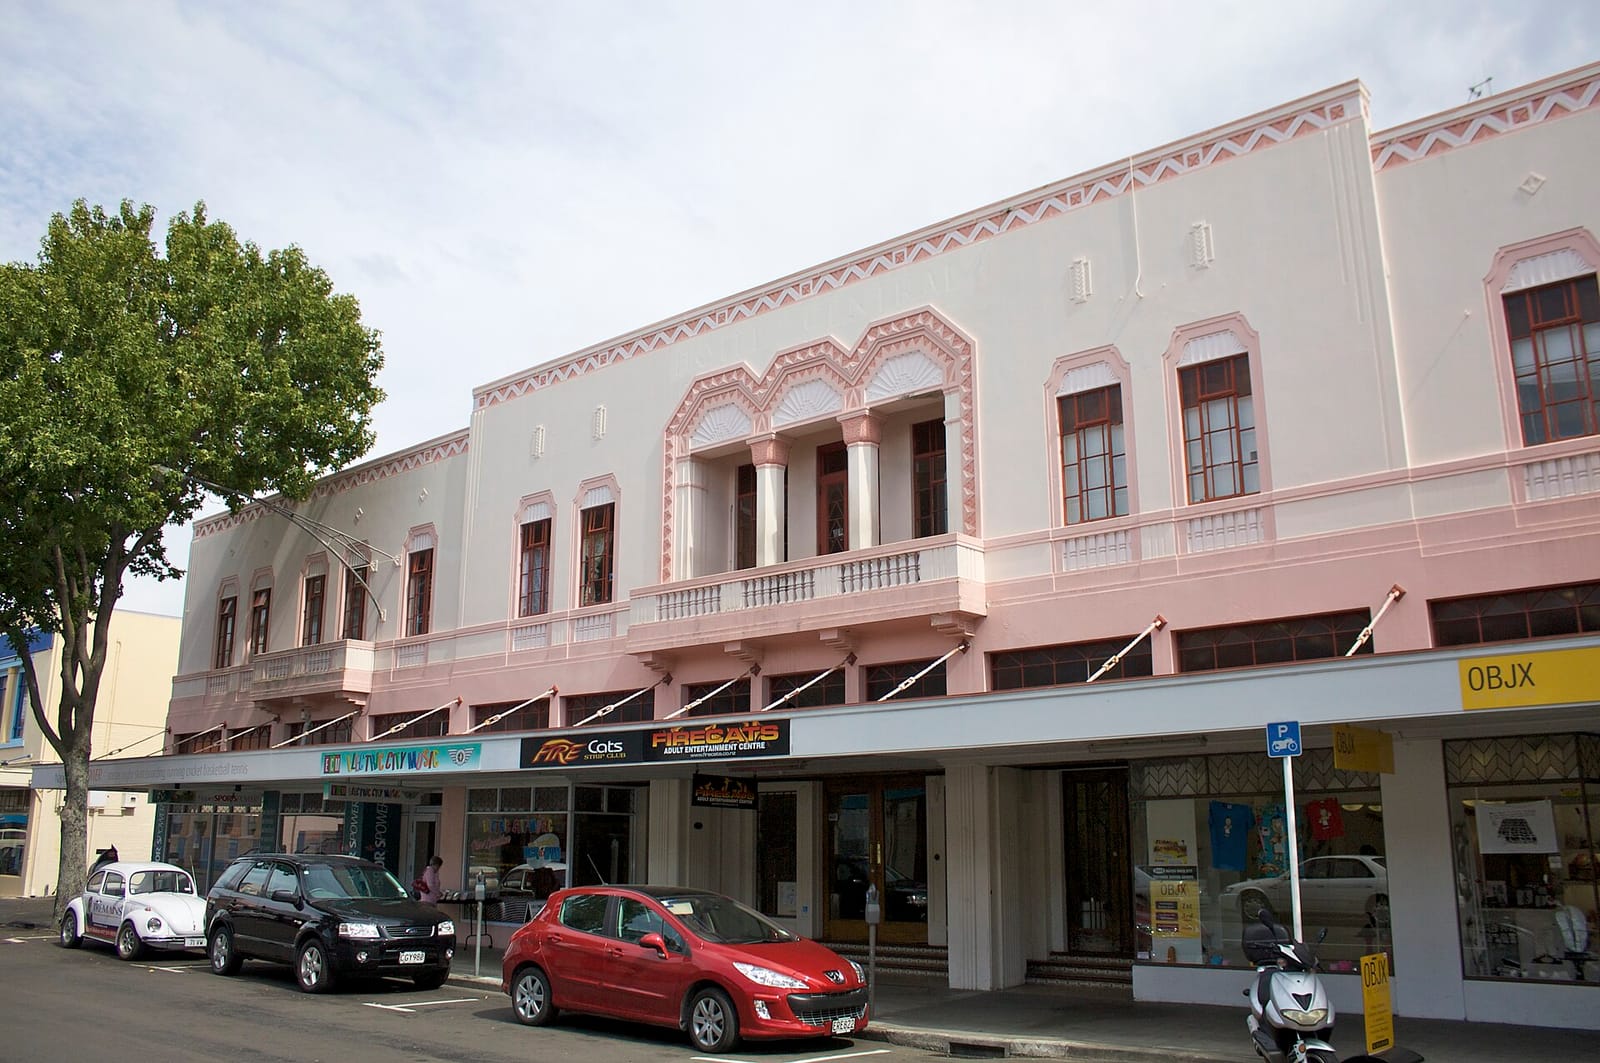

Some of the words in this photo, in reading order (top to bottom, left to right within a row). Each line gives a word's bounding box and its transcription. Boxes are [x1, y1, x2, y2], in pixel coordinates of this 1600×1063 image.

[1468, 662, 1535, 691] OBJX
[652, 723, 779, 747] FIRECATS
[1278, 725, 1288, 737] P
[531, 739, 587, 765] FIRE
[588, 740, 623, 753] Cats
[664, 746, 684, 754] ADULT
[685, 744, 737, 753] ENTERTAINMENT
[739, 742, 765, 750] CENTRE
[1364, 960, 1387, 987] OBJX
